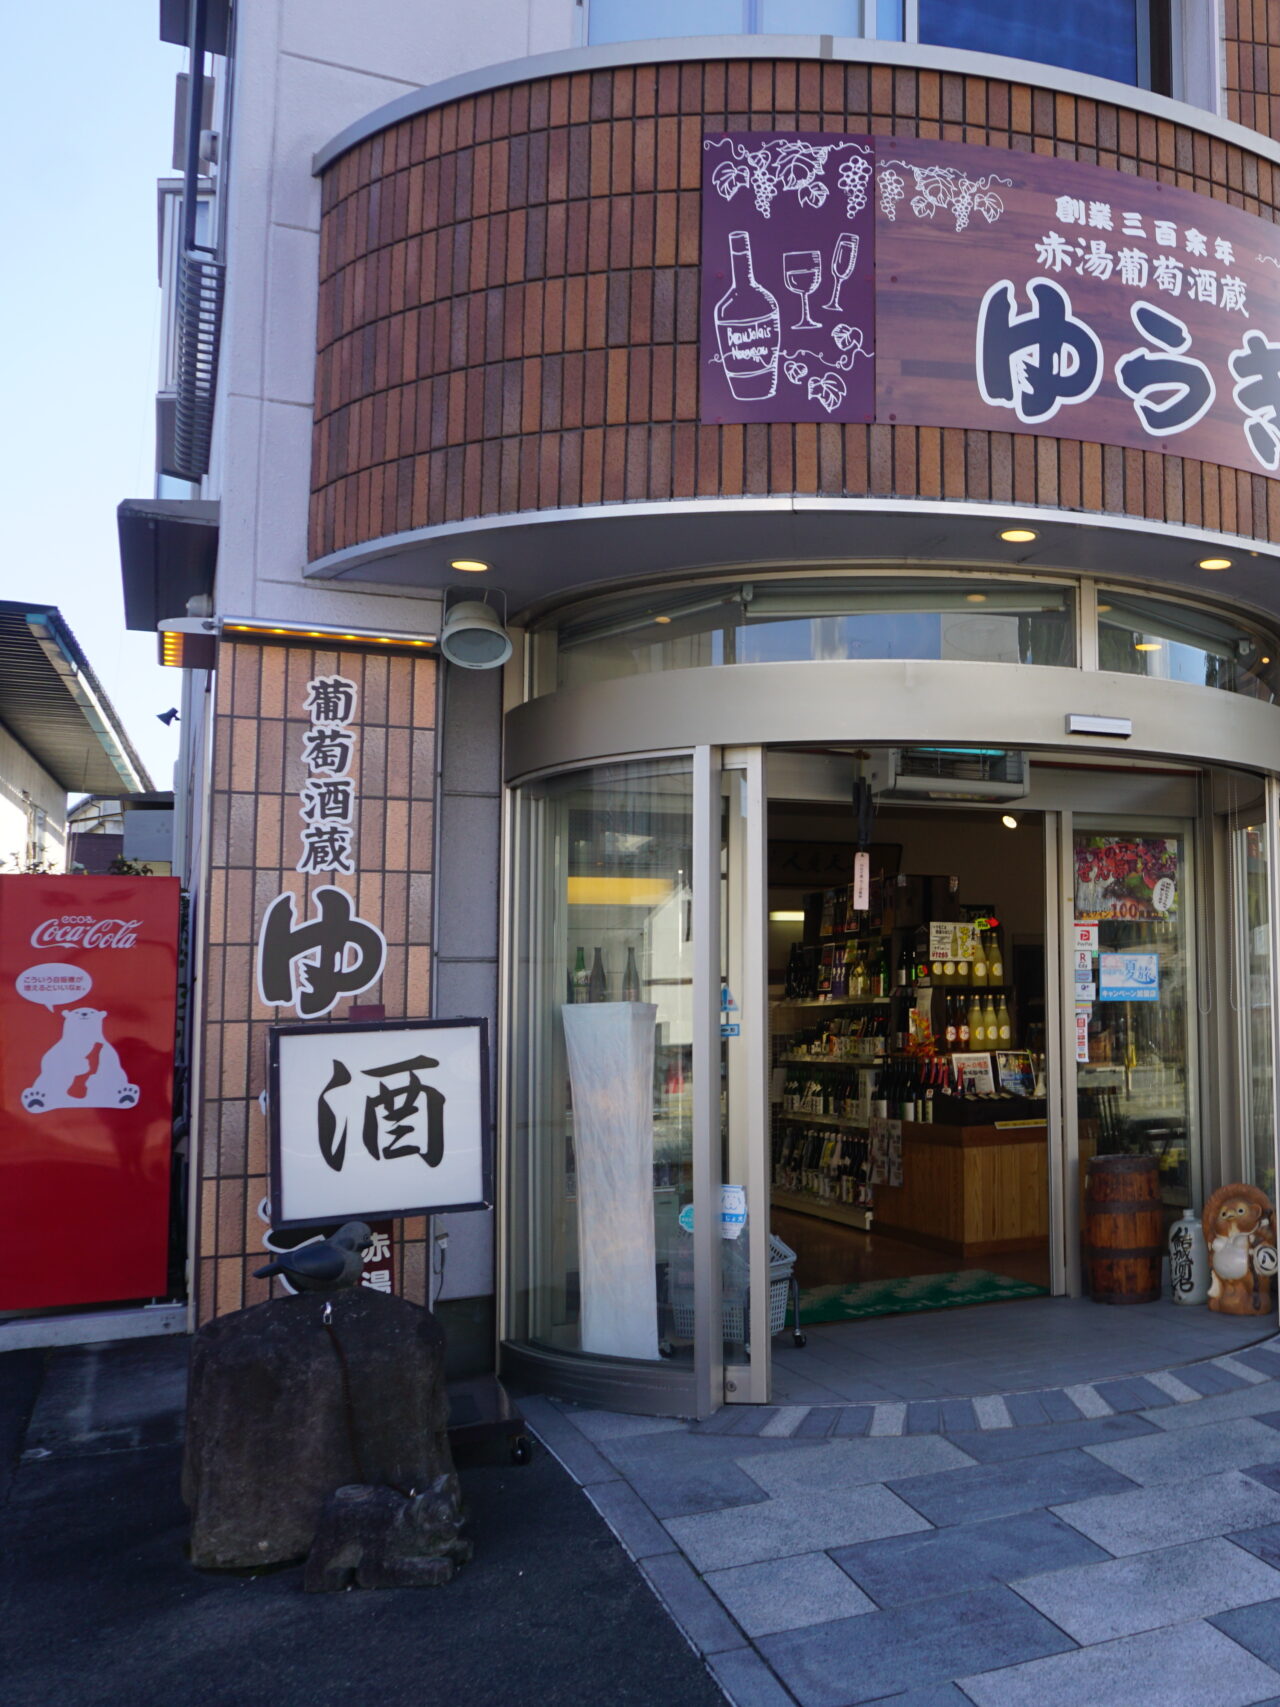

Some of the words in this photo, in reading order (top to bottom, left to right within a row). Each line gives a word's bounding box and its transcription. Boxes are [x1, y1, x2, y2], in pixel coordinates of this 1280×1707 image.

[1055, 195, 1236, 266] 創業三百余年
[1035, 231, 1250, 319] 赤湯葡萄酒蔵
[296, 674, 358, 876] 葡萄酒蔵
[30, 918, 144, 949] Coca-Cola
[317, 1054, 447, 1173] 酒
